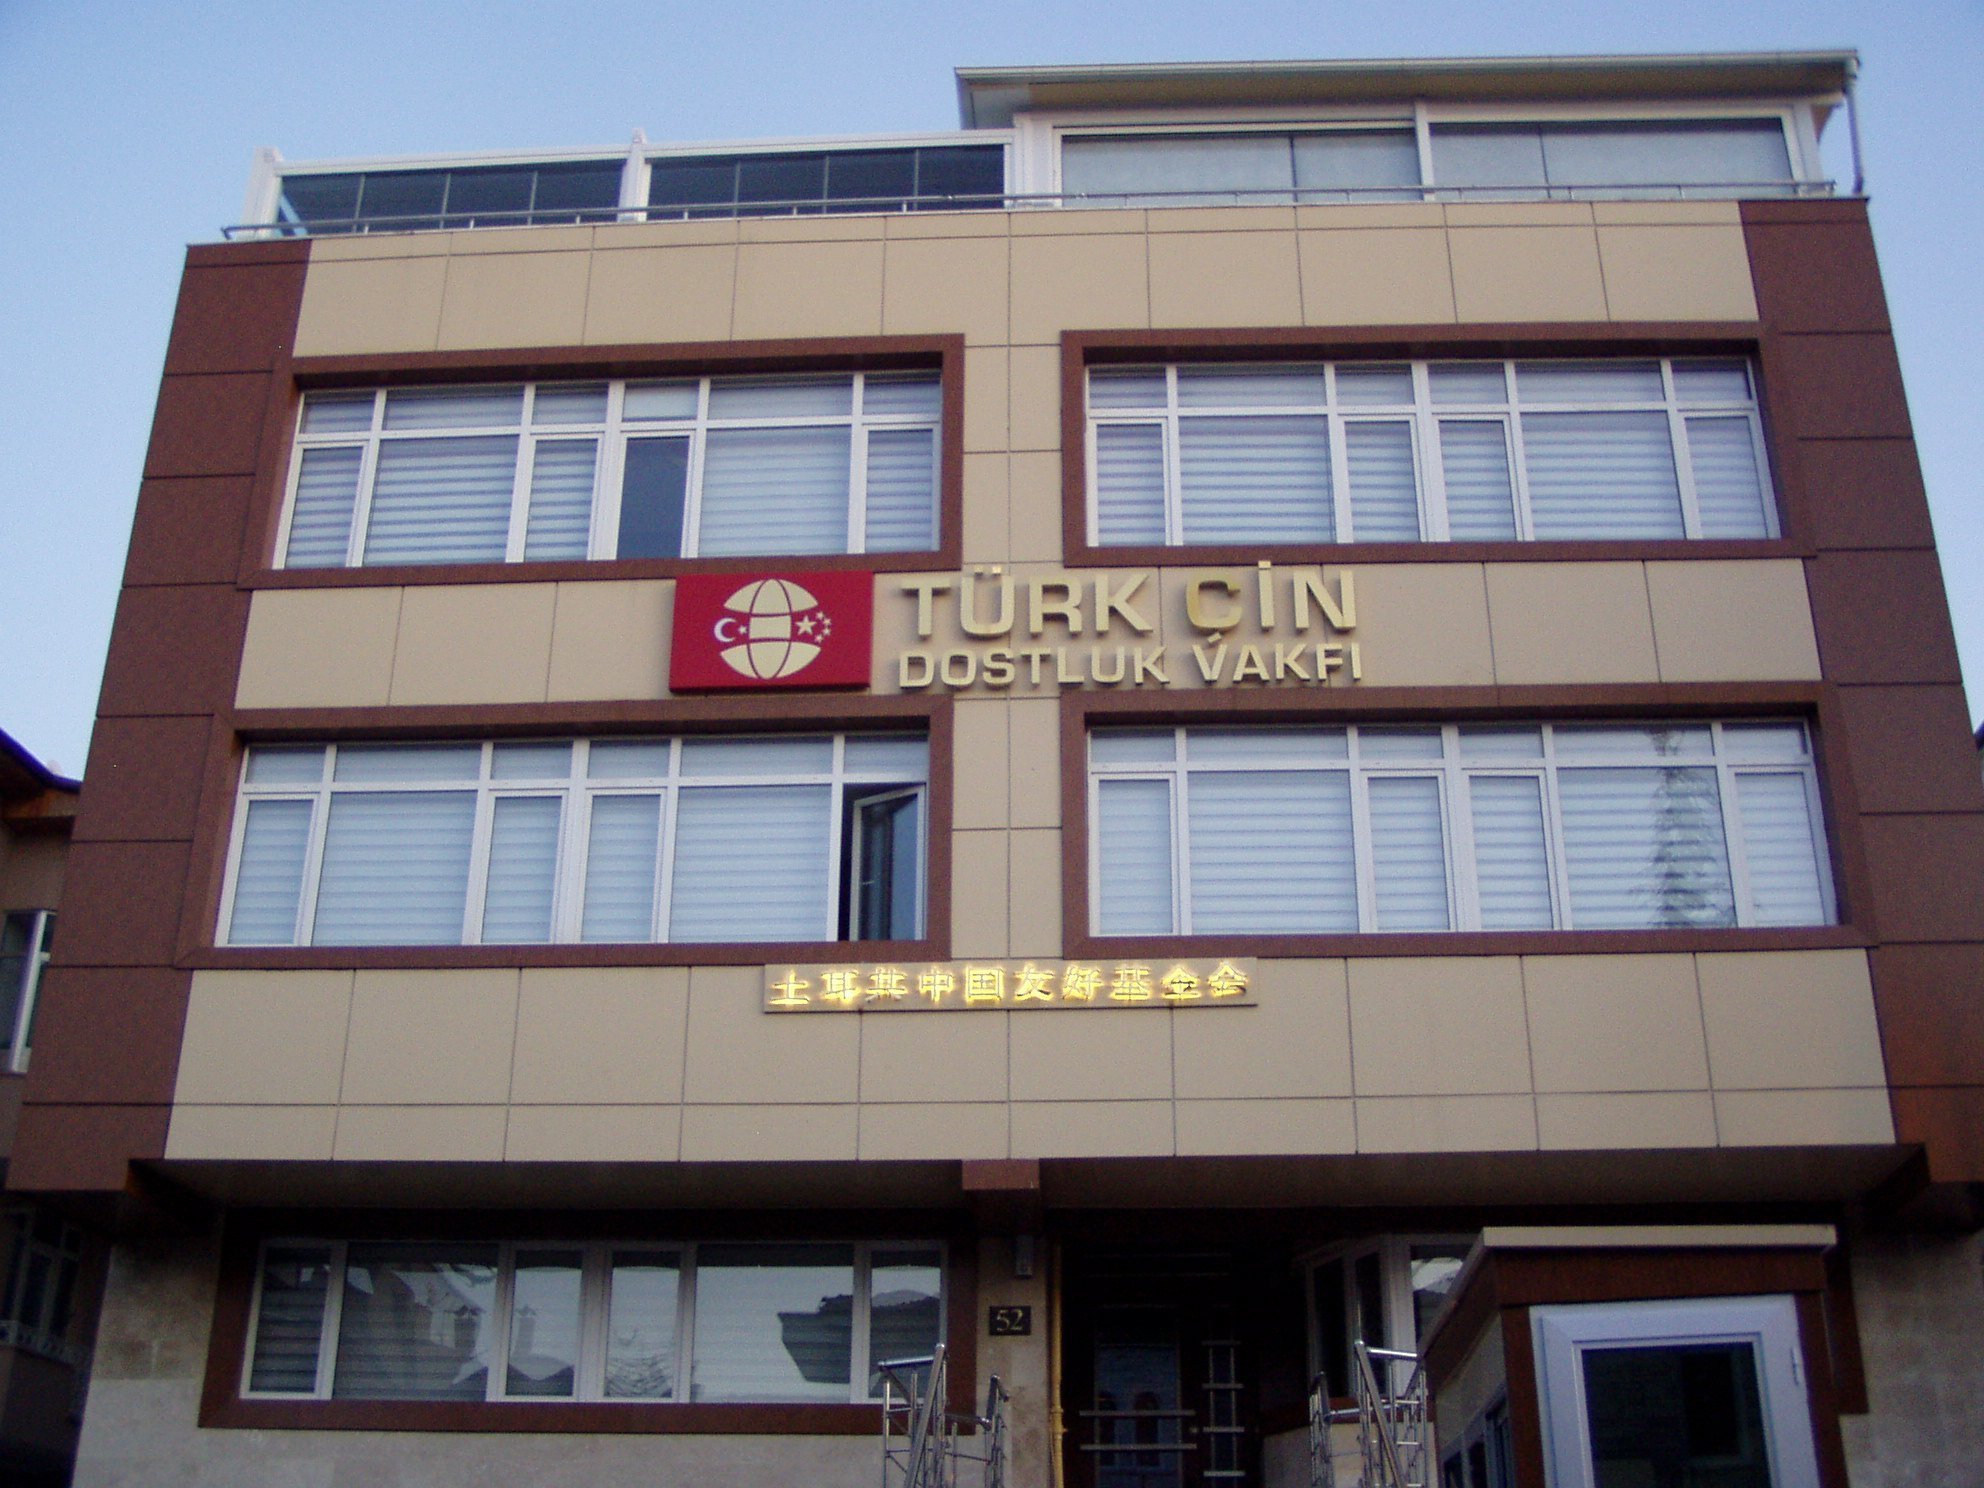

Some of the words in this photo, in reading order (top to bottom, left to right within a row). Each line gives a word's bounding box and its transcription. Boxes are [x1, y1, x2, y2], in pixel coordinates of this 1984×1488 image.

[901, 565, 1153, 641] TÜRK
[1186, 560, 1357, 644] ÇİN
[899, 646, 1170, 690] DOSTLUK
[1191, 642, 1362, 684] VAKFI
[769, 963, 1249, 1005] 土耳其中国友好基金会
[996, 1308, 1023, 1331] 52
